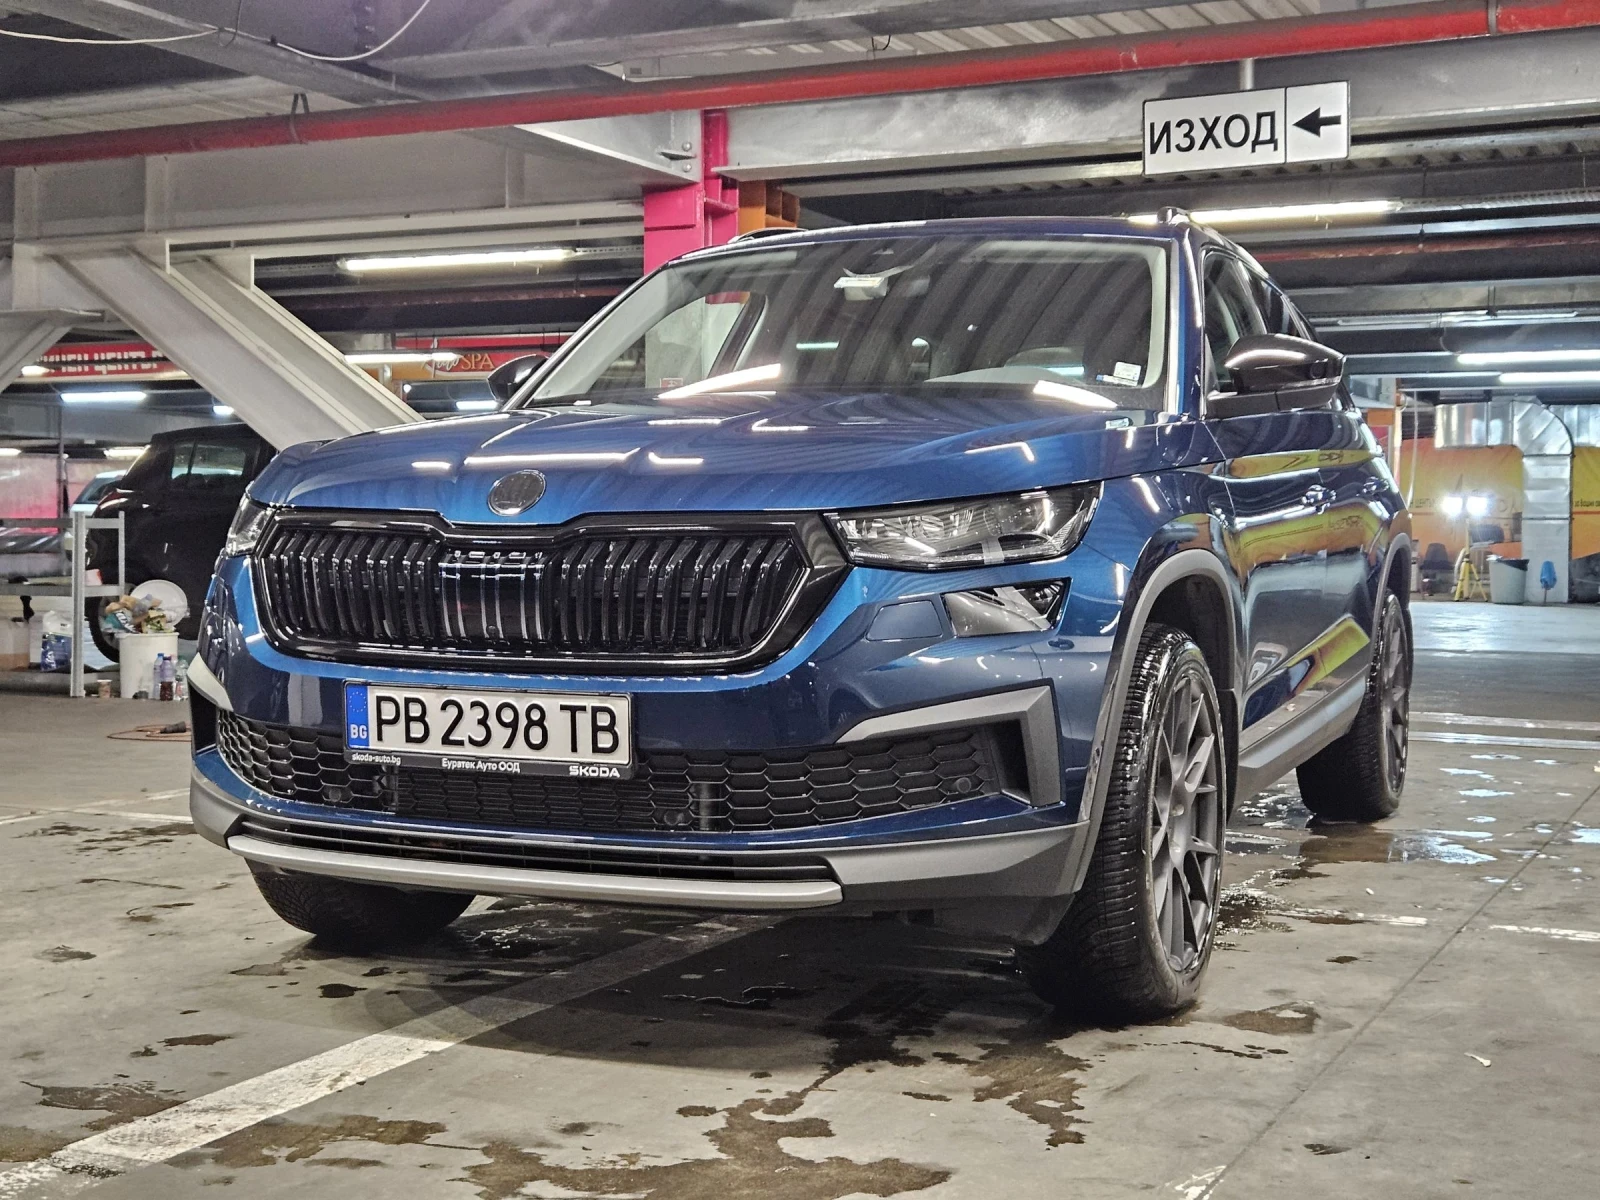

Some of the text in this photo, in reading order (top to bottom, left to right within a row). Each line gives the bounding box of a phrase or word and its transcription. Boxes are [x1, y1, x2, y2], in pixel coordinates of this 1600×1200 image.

[1149, 110, 1279, 155] ИЗХОД
[461, 353, 495, 370] SPA
[350, 724, 368, 738] BG
[375, 695, 620, 754] PB 2398 TB
[351, 752, 401, 766] skoda-auto.bg
[441, 758, 520, 774] Еуратек Ауто ООД
